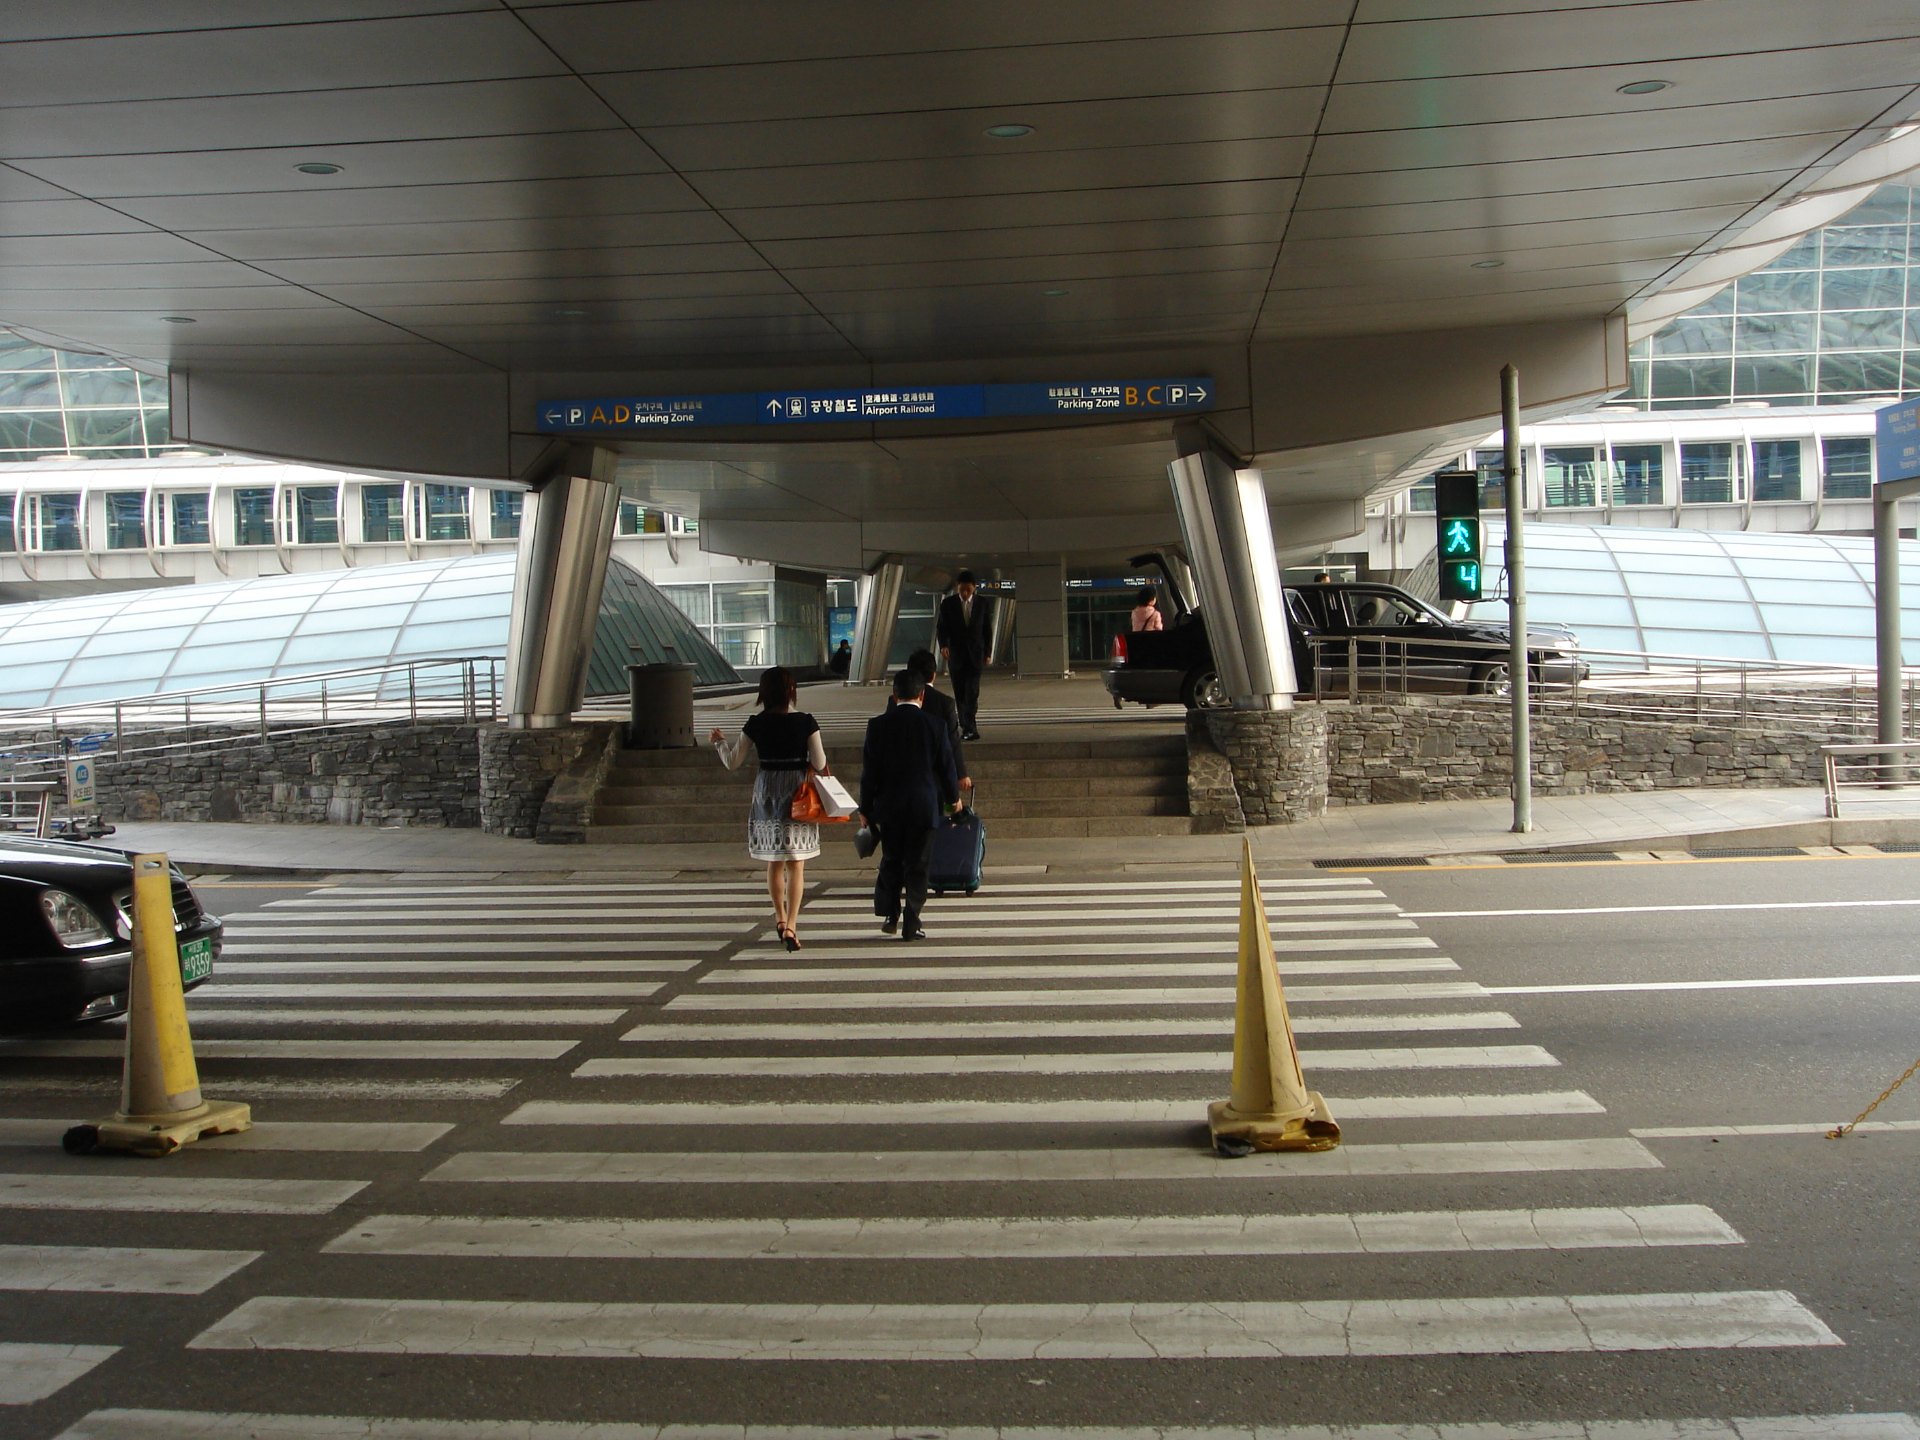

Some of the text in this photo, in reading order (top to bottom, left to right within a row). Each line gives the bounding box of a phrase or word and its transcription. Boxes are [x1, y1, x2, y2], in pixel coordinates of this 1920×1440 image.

[1171, 388, 1184, 403] P
[811, 399, 858, 414] 공항철도
[866, 404, 935, 416] Airport Railroad
[1057, 398, 1120, 410] Parking Zone
[570, 408, 582, 423] P
[635, 413, 695, 424] Parking Zone
[1461, 565, 1476, 590] 4
[73, 788, 83, 799] ACE
[191, 951, 209, 977] 9359
